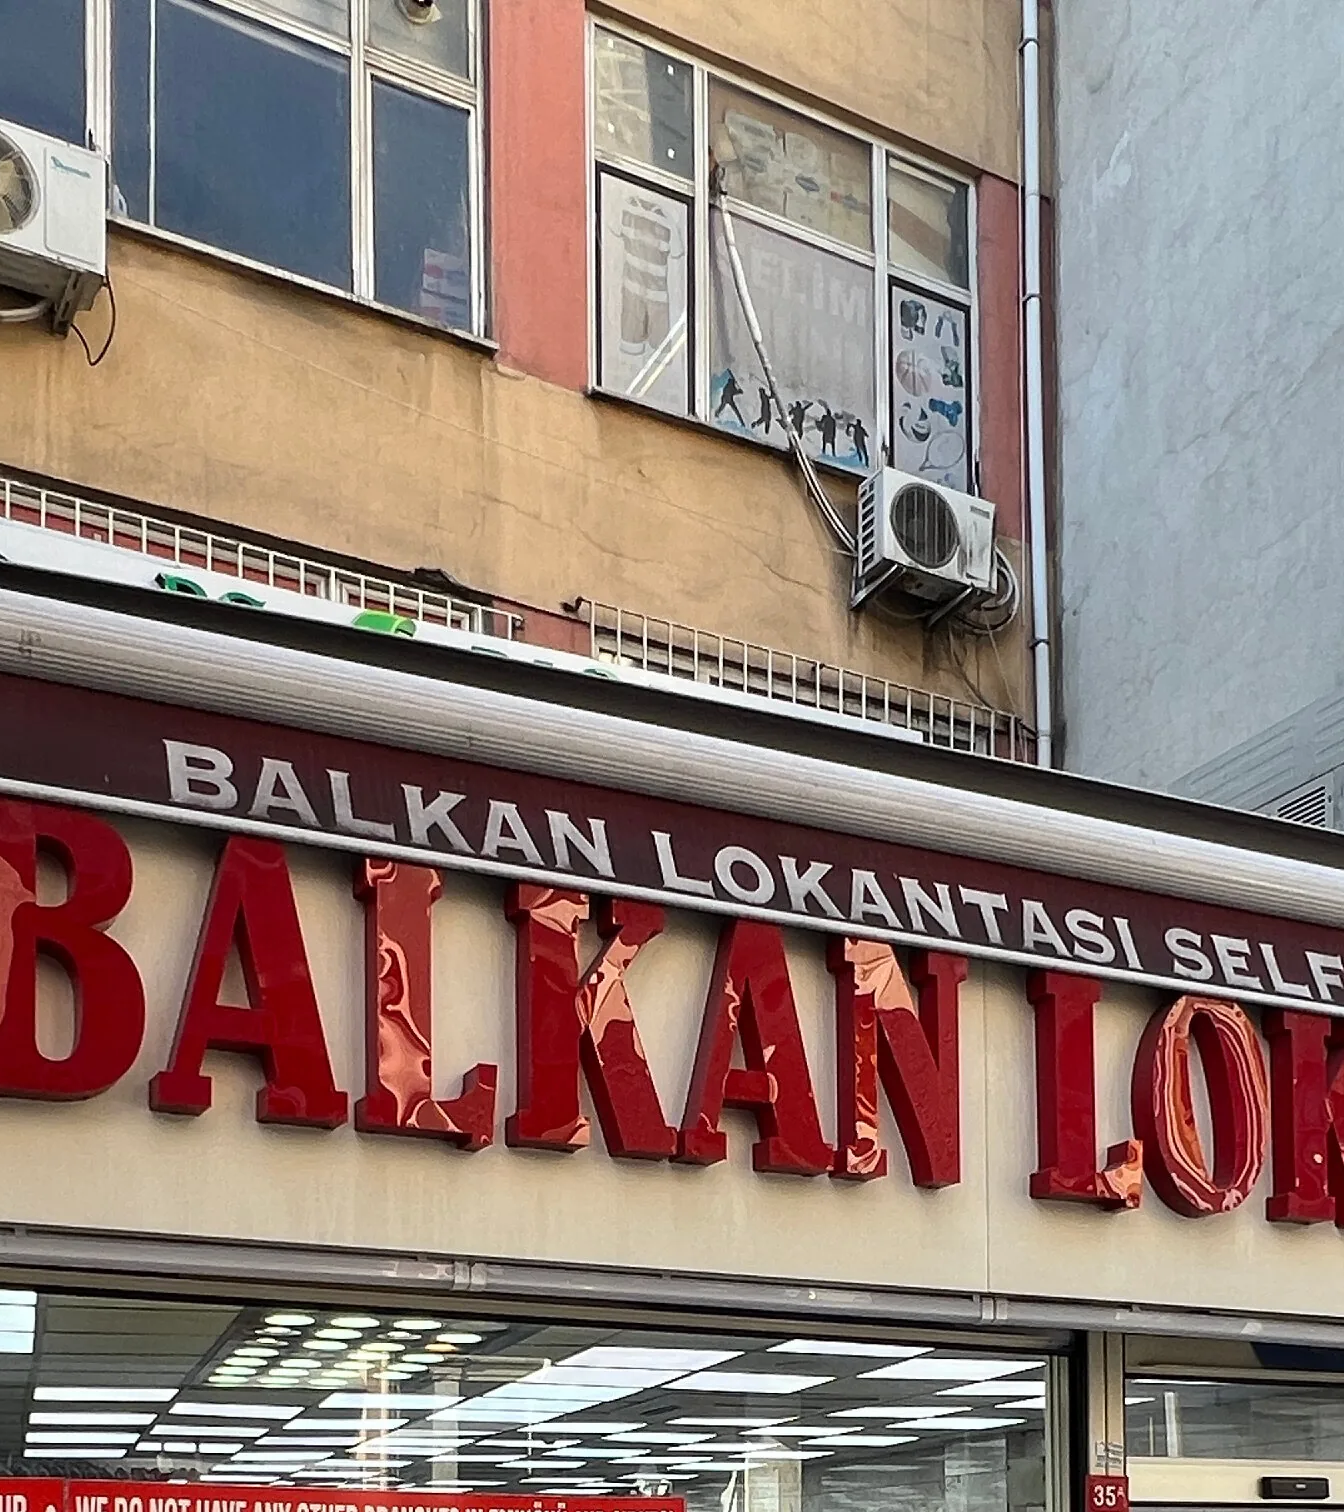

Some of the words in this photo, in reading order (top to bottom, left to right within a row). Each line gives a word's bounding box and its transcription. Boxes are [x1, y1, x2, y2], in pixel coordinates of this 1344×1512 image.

[162, 738, 617, 879] BALKAN
[651, 829, 1142, 971] LOKANTASI
[1164, 927, 1344, 1002] SELF
